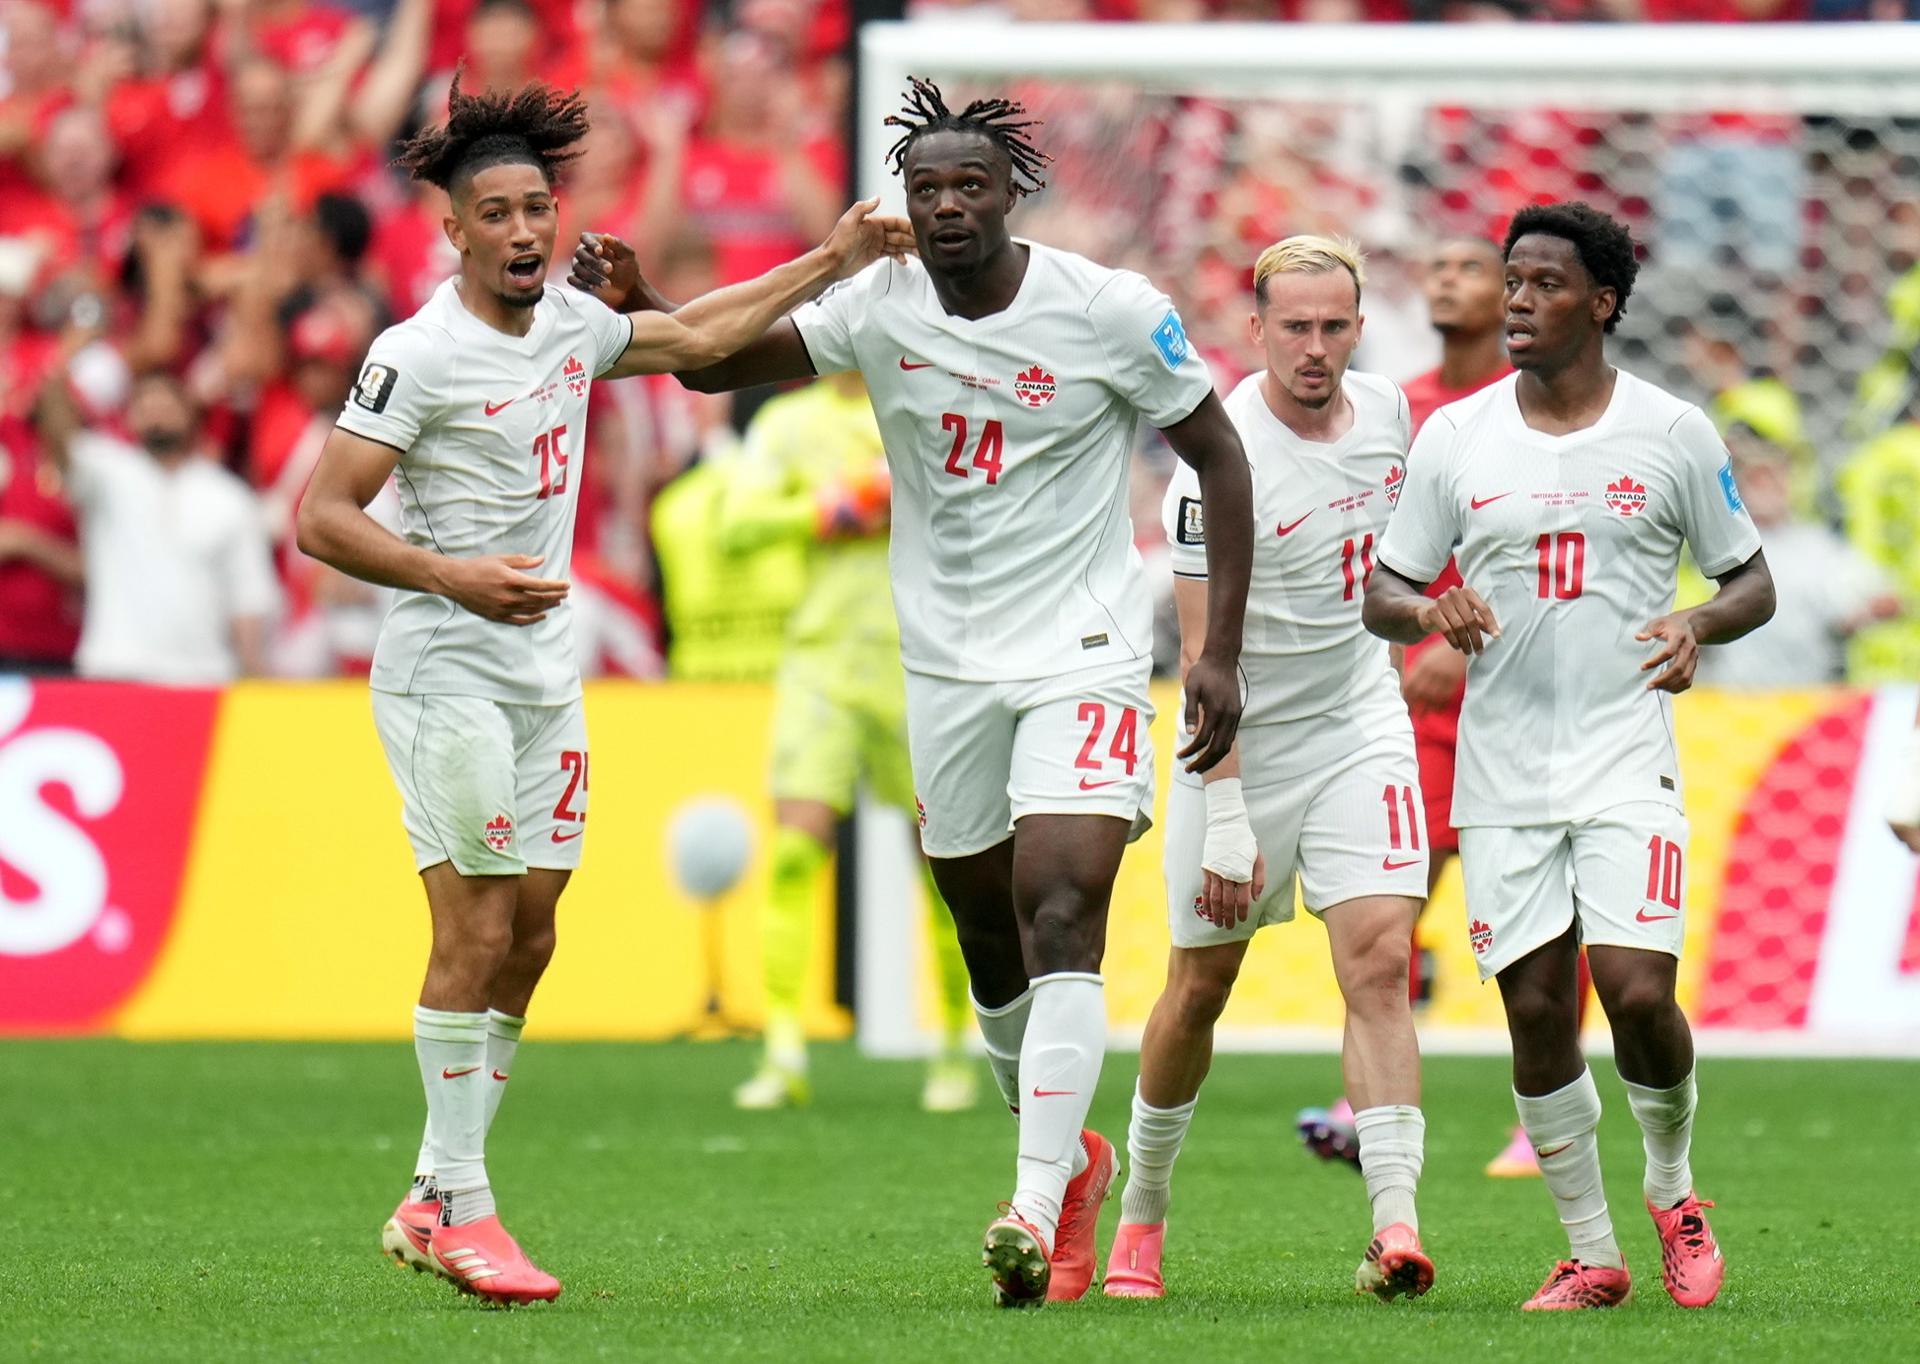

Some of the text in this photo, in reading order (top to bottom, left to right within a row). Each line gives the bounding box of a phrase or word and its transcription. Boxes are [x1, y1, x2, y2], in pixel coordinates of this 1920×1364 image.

[564, 371, 586, 383] CANADA
[1014, 382, 1057, 392] CANADA
[942, 412, 1005, 485] 24
[1384, 482, 1401, 494] CANA
[1604, 493, 1647, 502] CANADA
[1341, 533, 1374, 602] 11
[1535, 532, 1585, 600] 10
[1074, 702, 1138, 777] 24
[1382, 784, 1420, 851] 11
[1646, 834, 1682, 911] 10
[1471, 931, 1493, 942] ANADA
